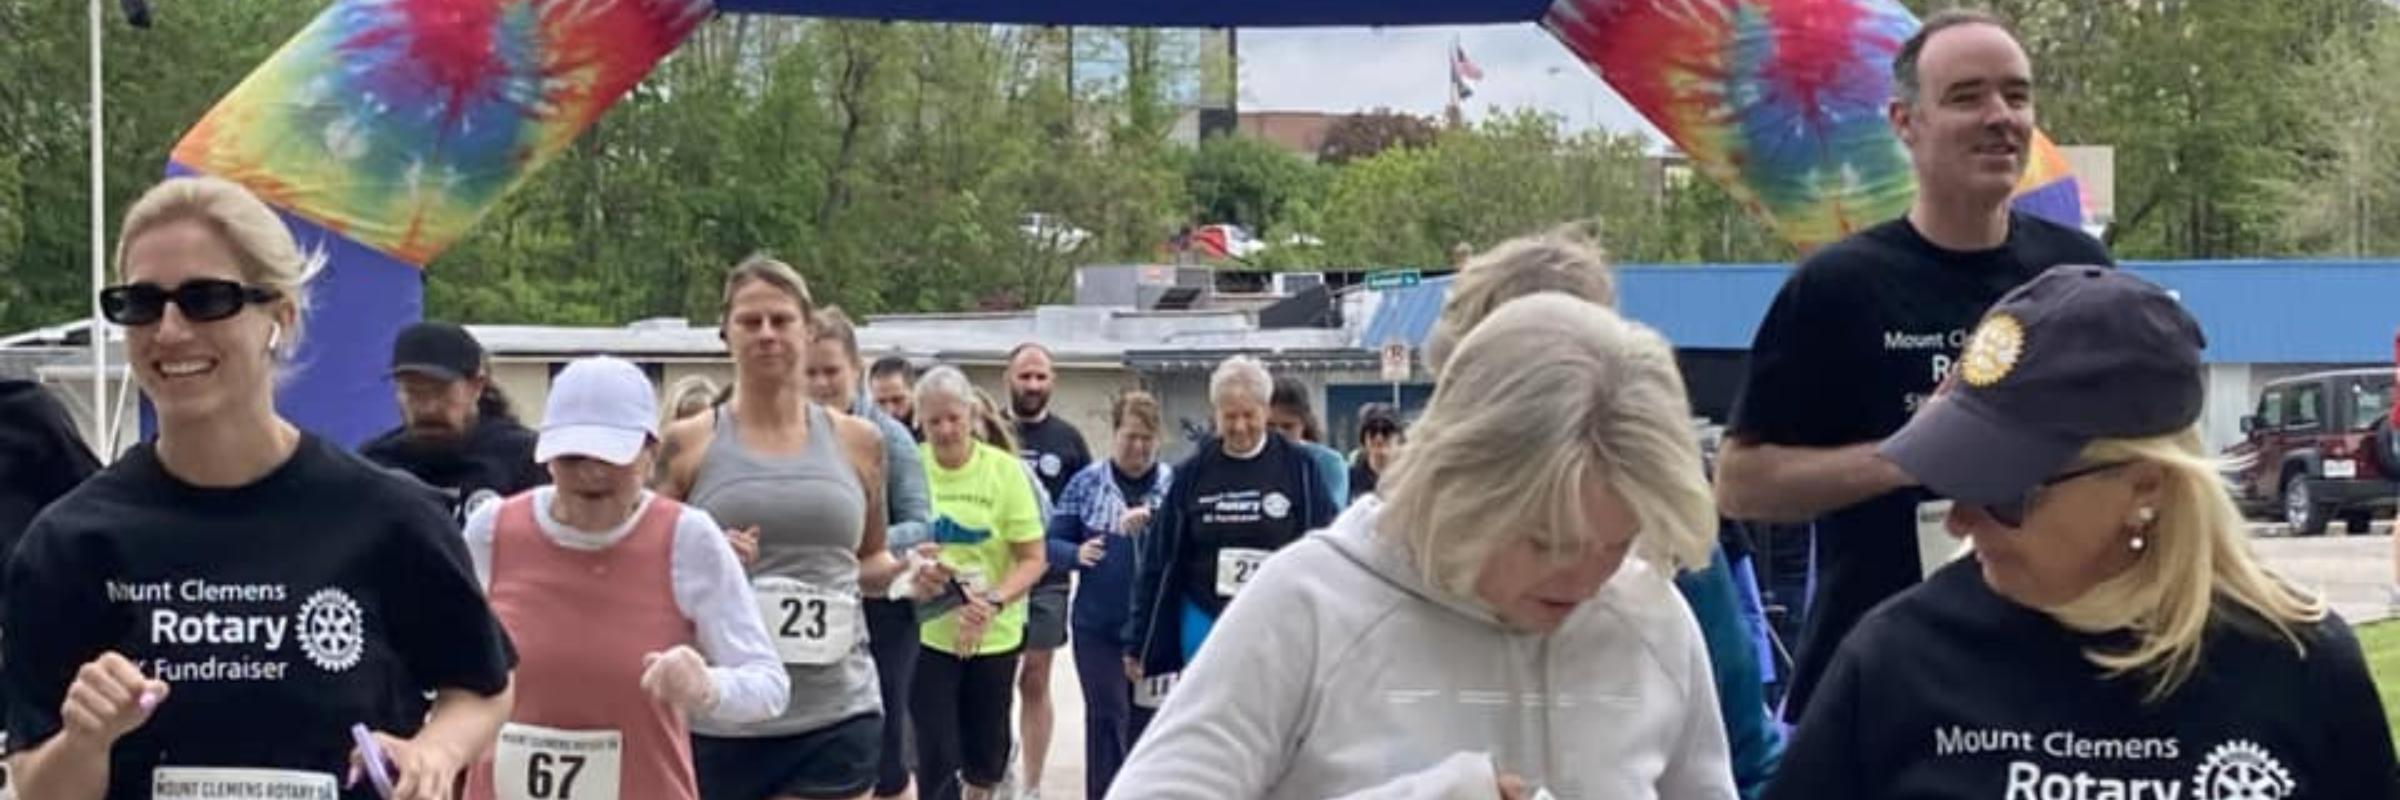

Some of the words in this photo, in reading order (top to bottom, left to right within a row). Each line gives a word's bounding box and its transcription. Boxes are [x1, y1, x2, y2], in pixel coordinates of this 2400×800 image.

[1884, 331, 1944, 349] Mount
[1235, 561, 1260, 583] 2
[180, 579, 286, 601] Clemens
[151, 609, 288, 649] Rotary
[780, 598, 827, 639] 23
[154, 657, 288, 681] Fundraiser
[1935, 725, 2034, 755] Mount
[2042, 732, 2180, 759] Clemens
[528, 752, 586, 799] 67
[2004, 761, 2181, 800] Rotary
[157, 782, 198, 798] MOUNT
[202, 782, 263, 799] CLEMENS
[267, 784, 313, 800] ROTARY
